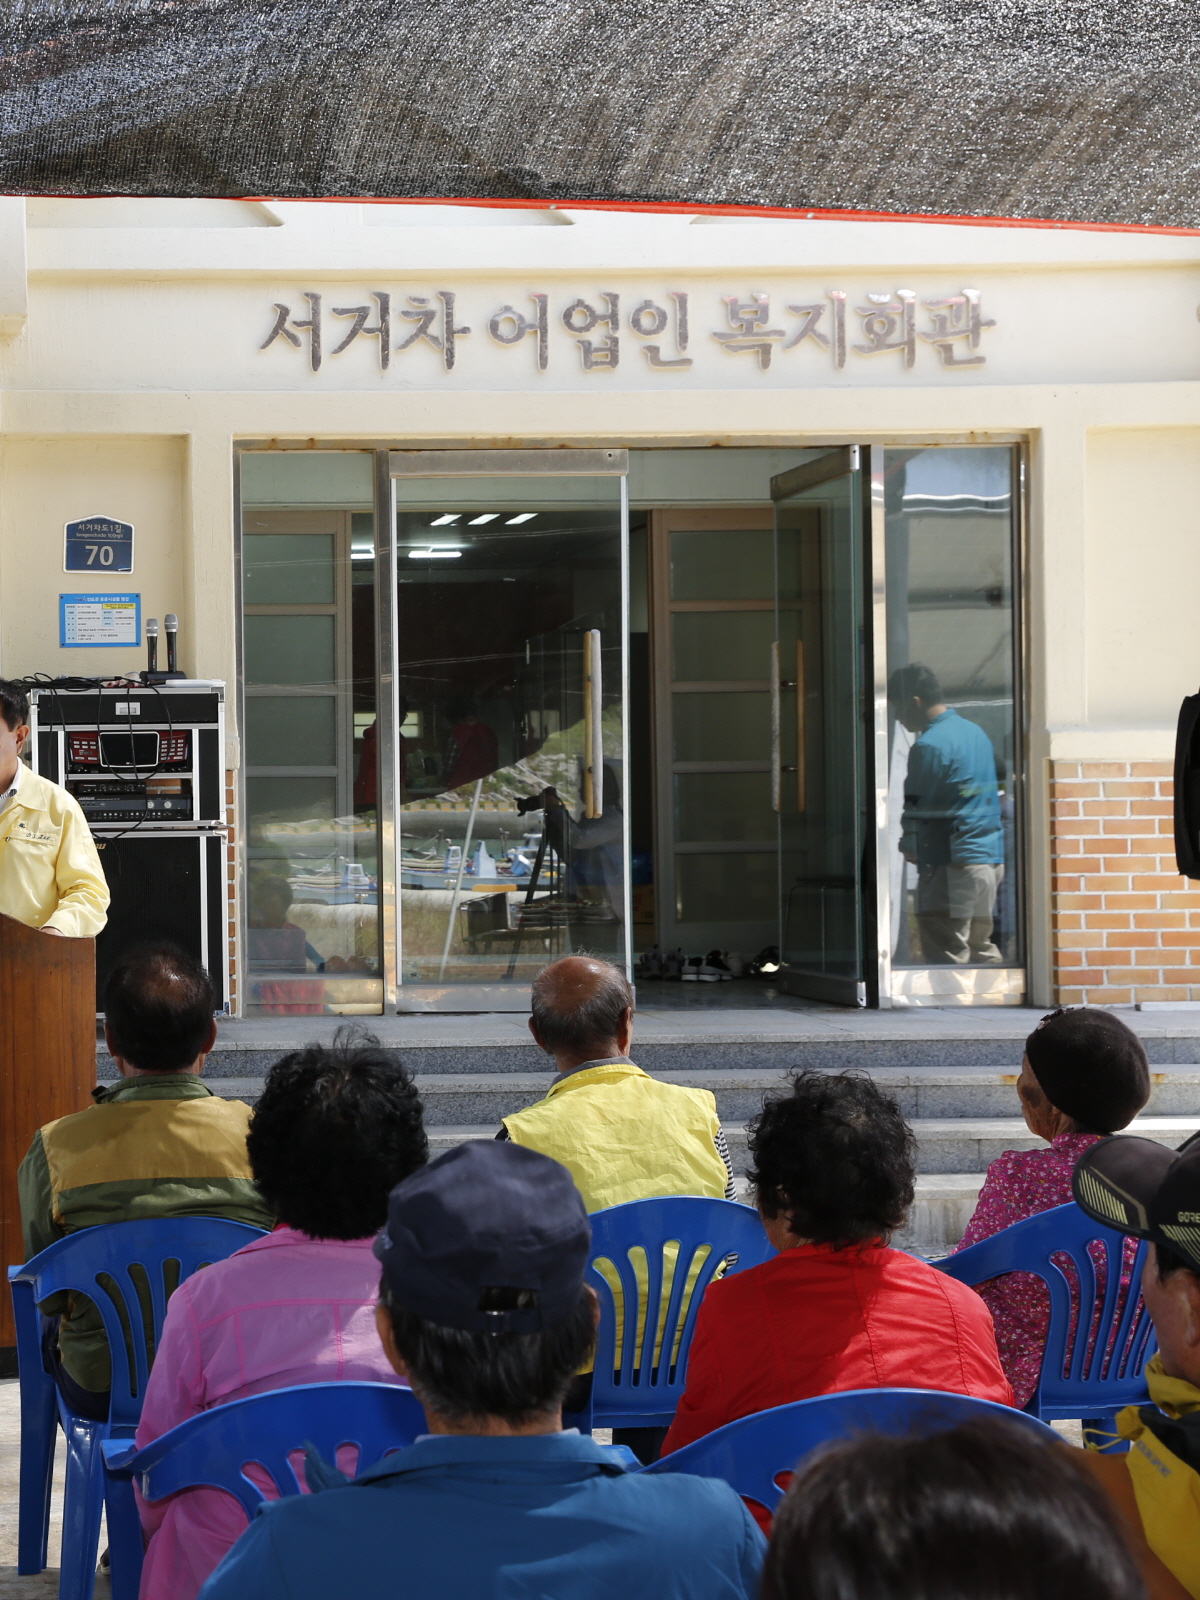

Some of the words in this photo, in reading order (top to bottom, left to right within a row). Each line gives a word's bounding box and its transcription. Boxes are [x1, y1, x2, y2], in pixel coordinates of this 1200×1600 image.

[259, 291, 472, 372] 서거차
[487, 292, 694, 372] 어업인
[711, 289, 997, 370] 복지회관
[77, 523, 123, 534] 서거차도1길
[85, 545, 114, 566] 70
